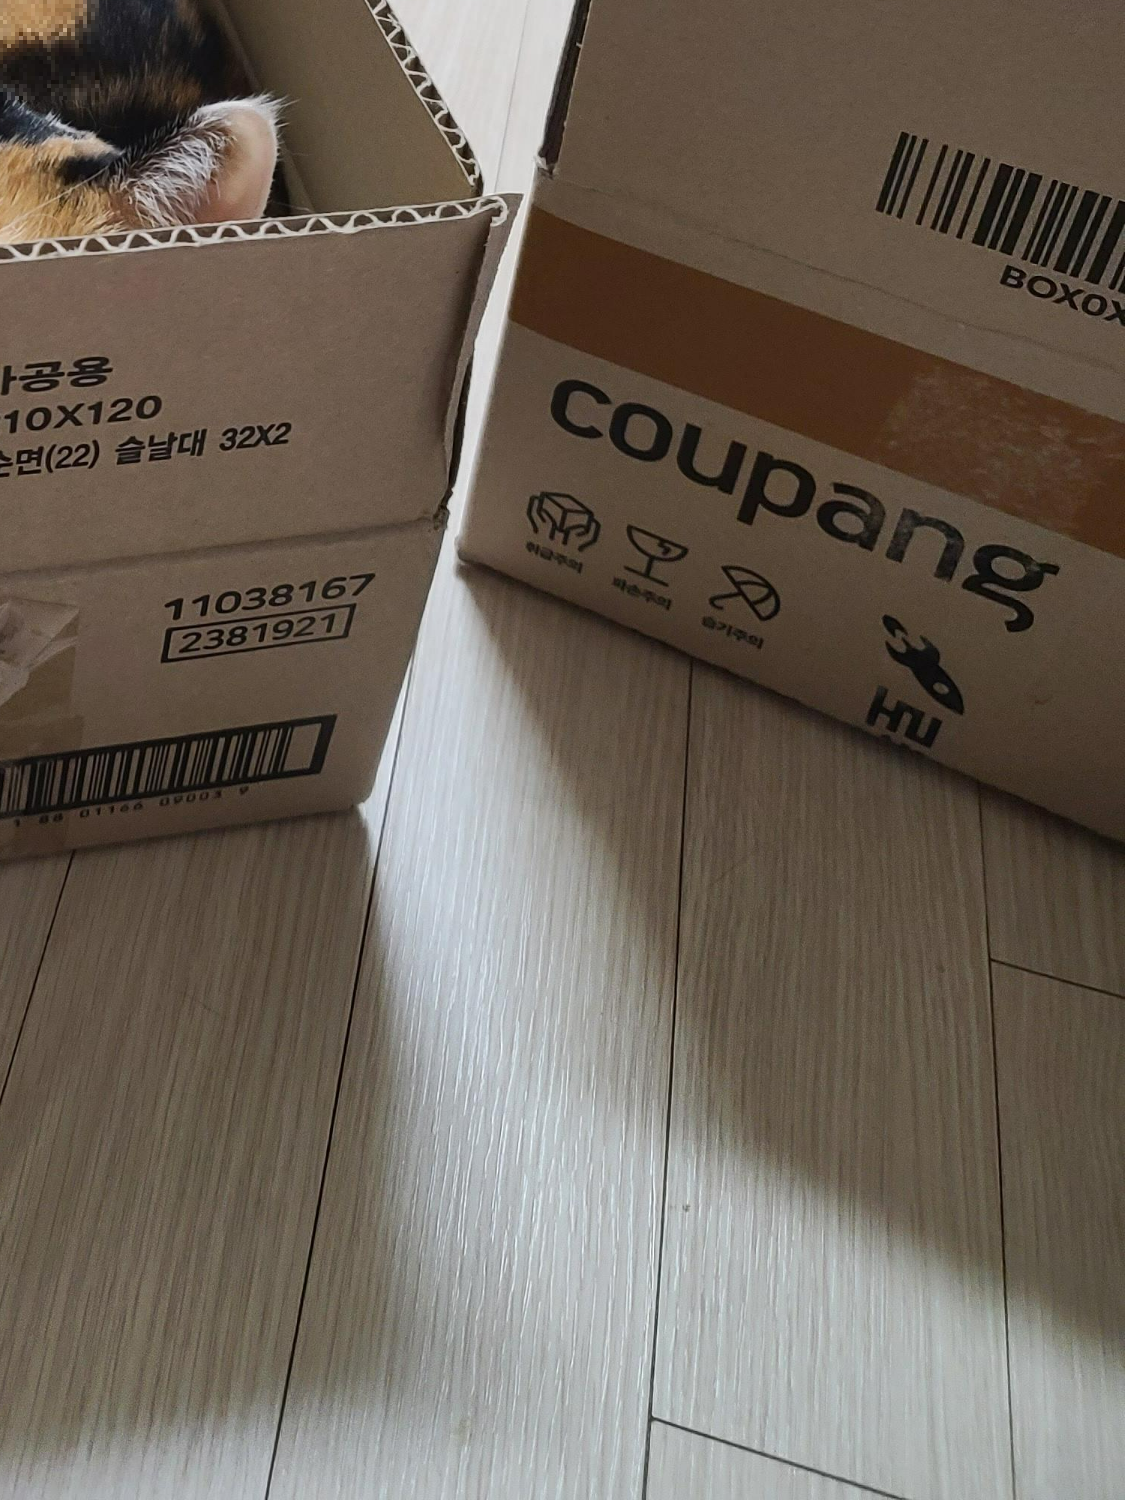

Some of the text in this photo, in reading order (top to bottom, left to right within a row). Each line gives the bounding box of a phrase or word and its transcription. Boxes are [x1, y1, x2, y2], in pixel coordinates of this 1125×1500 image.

[219, 422, 293, 451] 32X2
[550, 379, 1060, 633] coupang
[164, 573, 376, 620] 11038167
[178, 613, 336, 653] 2381921
